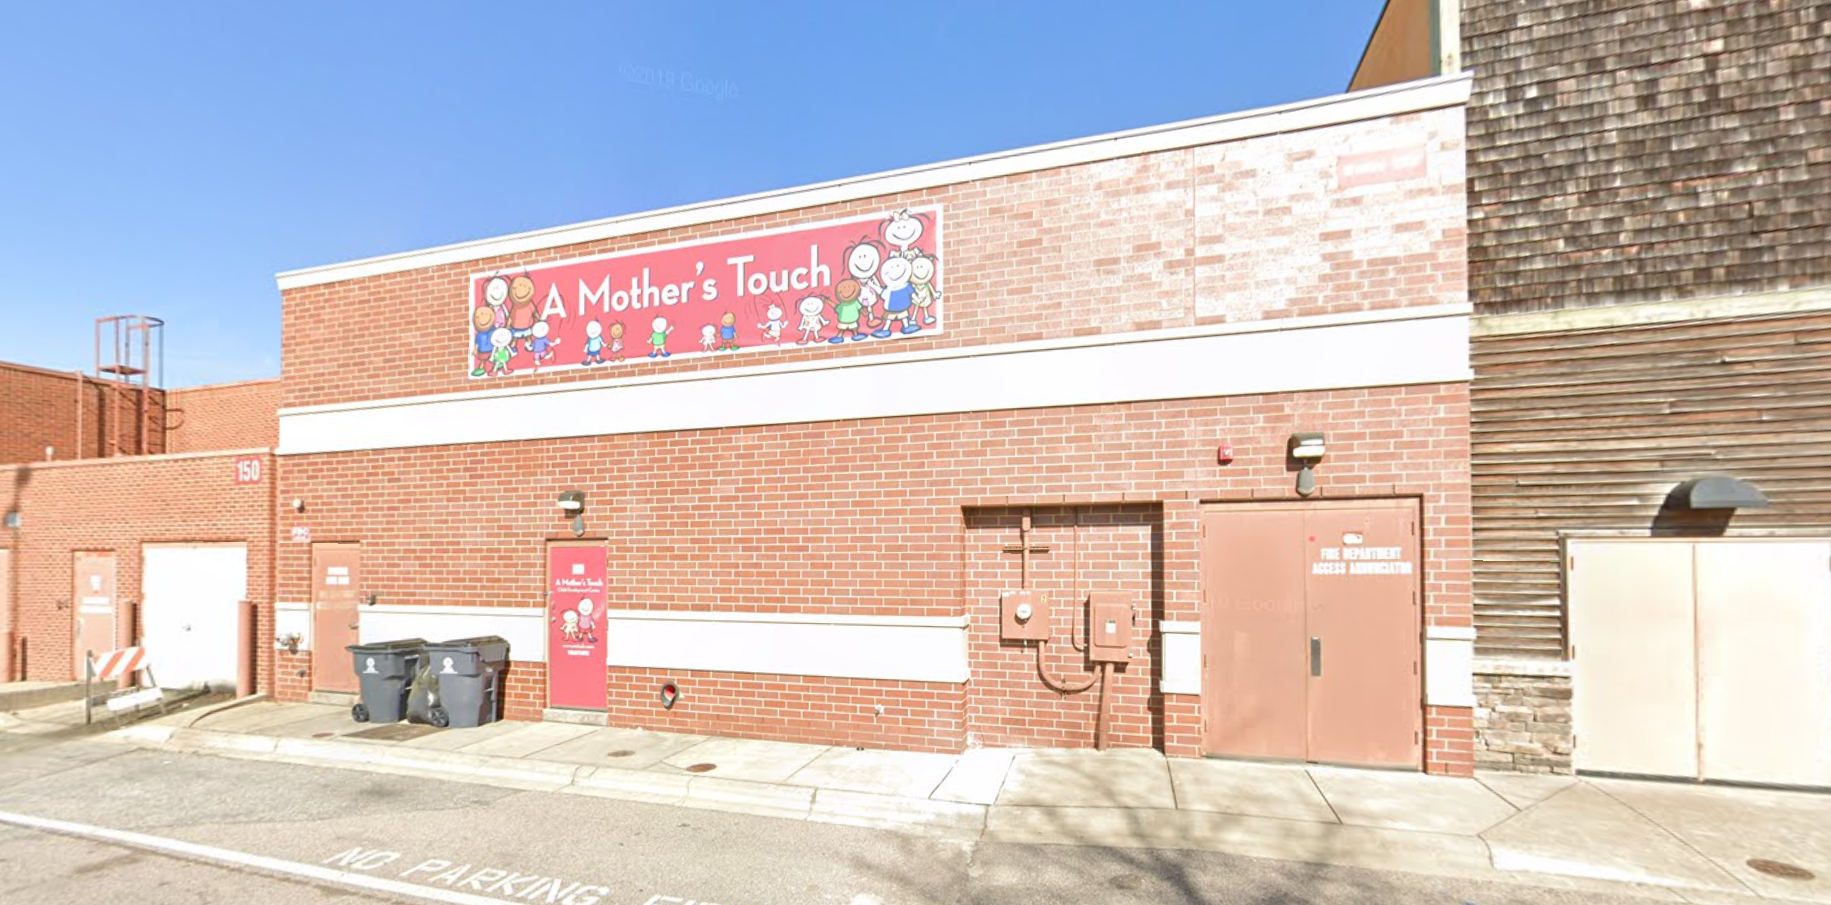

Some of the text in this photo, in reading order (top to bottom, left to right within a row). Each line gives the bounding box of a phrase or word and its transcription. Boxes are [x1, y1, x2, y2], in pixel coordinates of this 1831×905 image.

[541, 244, 832, 320] A Mother's Touch
[237, 459, 261, 482] 150
[1320, 547, 1402, 560] FIRE DEPARTMENT
[1312, 562, 1346, 575] ACCESS
[586, 578, 604, 586] Touch
[322, 847, 611, 905] NO PARKING
